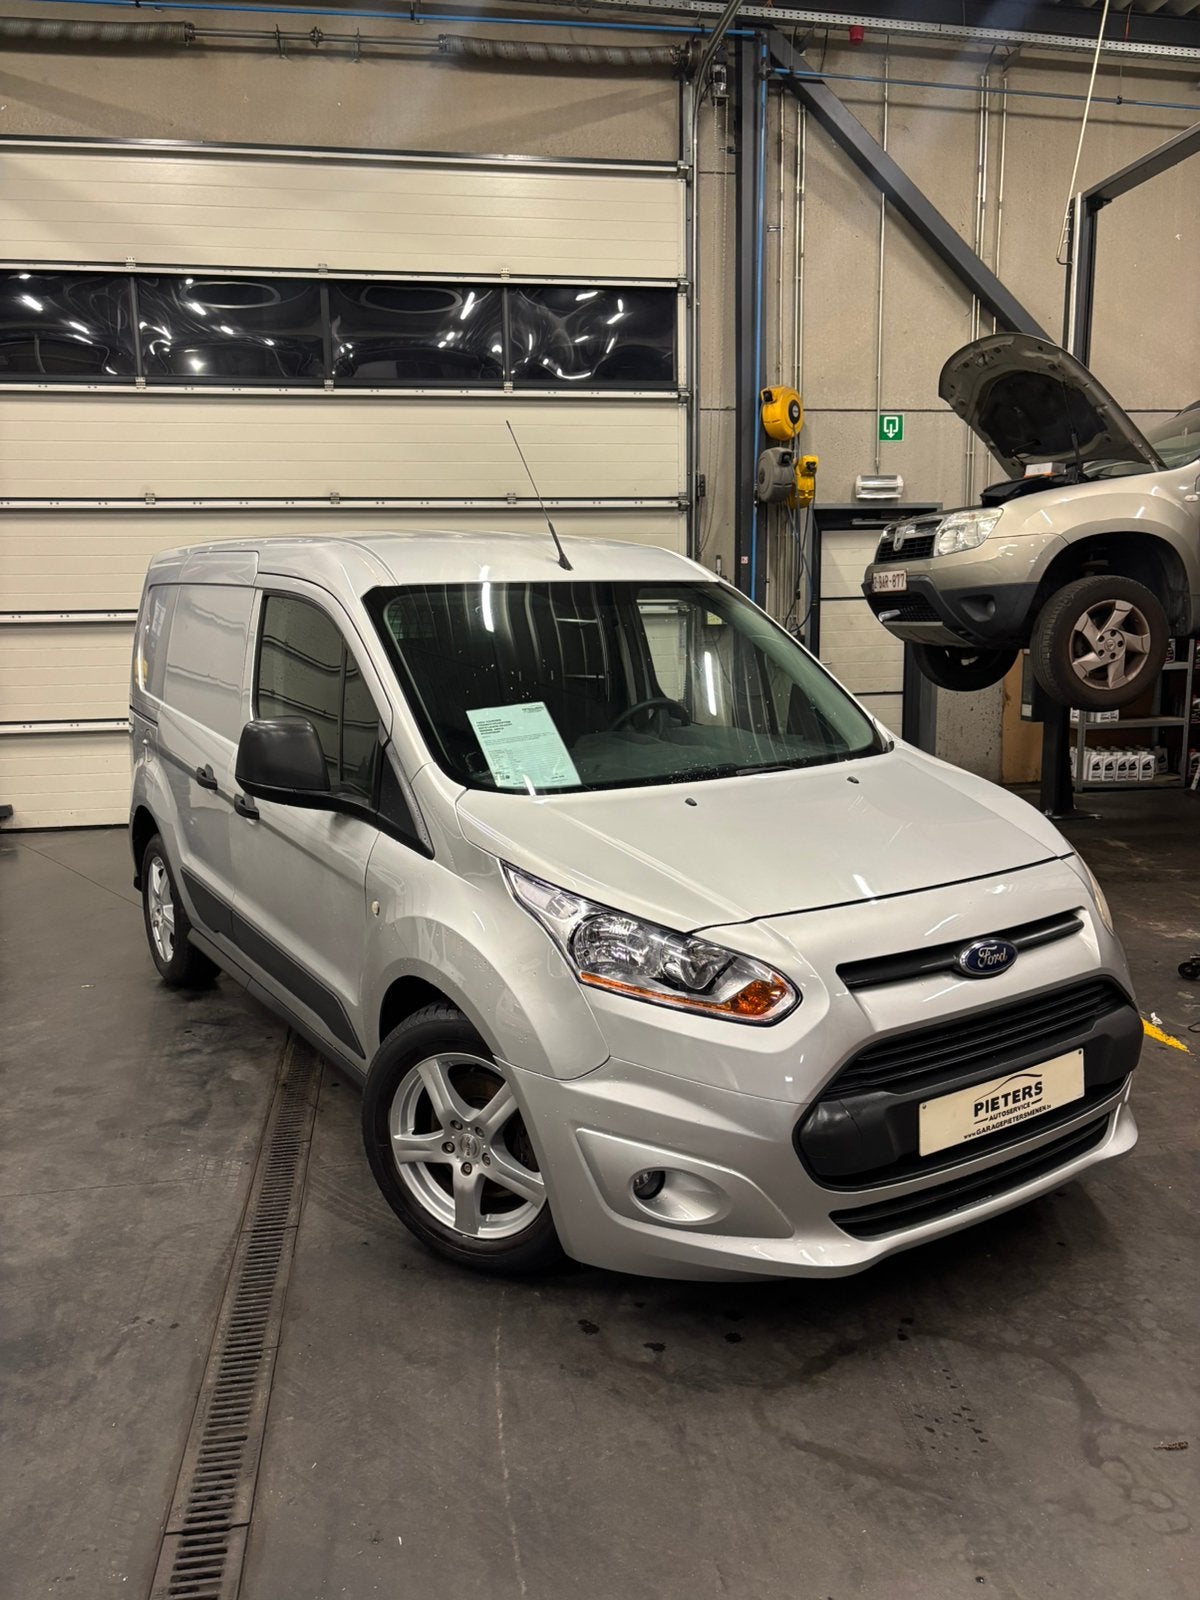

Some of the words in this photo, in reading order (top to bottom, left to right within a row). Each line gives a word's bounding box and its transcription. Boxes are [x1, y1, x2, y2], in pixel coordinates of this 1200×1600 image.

[977, 945, 1008, 968] Ford
[974, 1081, 1043, 1118] PIETERS
[988, 1102, 1031, 1121] AUTOSERVICE
